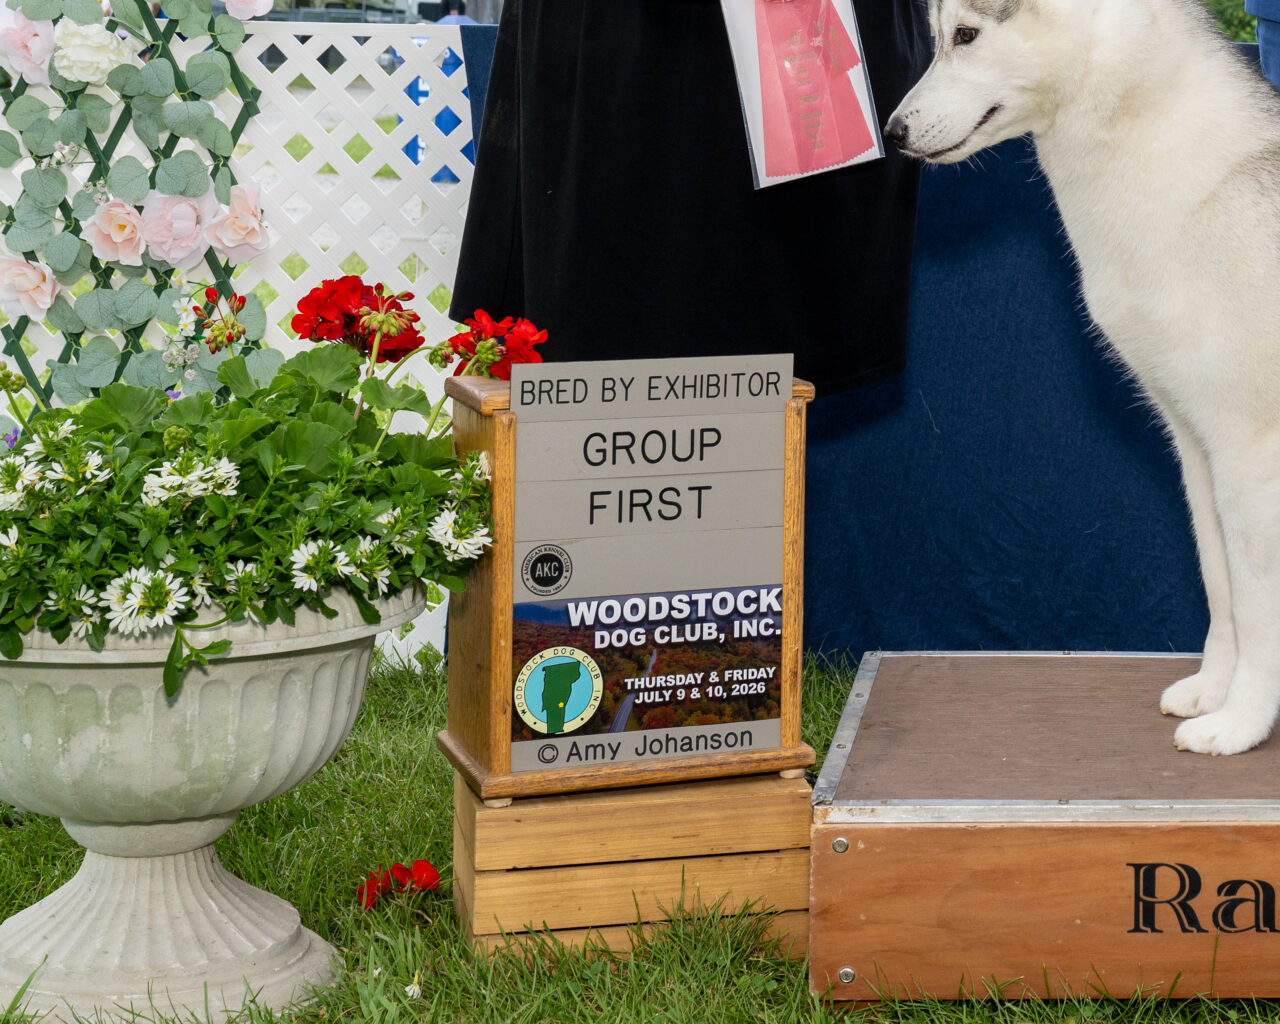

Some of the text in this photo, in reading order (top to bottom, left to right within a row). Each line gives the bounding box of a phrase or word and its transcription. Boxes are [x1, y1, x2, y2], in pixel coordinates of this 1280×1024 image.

[520, 371, 781, 406] BRED BY EXHIBITOR
[583, 427, 722, 467] GROUP
[589, 485, 712, 525] FIRST
[524, 547, 543, 575] AMERICAN
[535, 562, 559, 578] AKC
[567, 587, 783, 627] WOODSTOCK
[594, 618, 782, 649] DOG CLUB, INC.
[515, 653, 546, 716] WOODSTOCK
[553, 647, 576, 656] DOG
[581, 655, 601, 680] CLUB
[624, 666, 777, 690] THURSDAY & FRIDAY
[634, 681, 766, 704] JULY 9 & 10, 2026
[634, 729, 753, 757] Johanson
